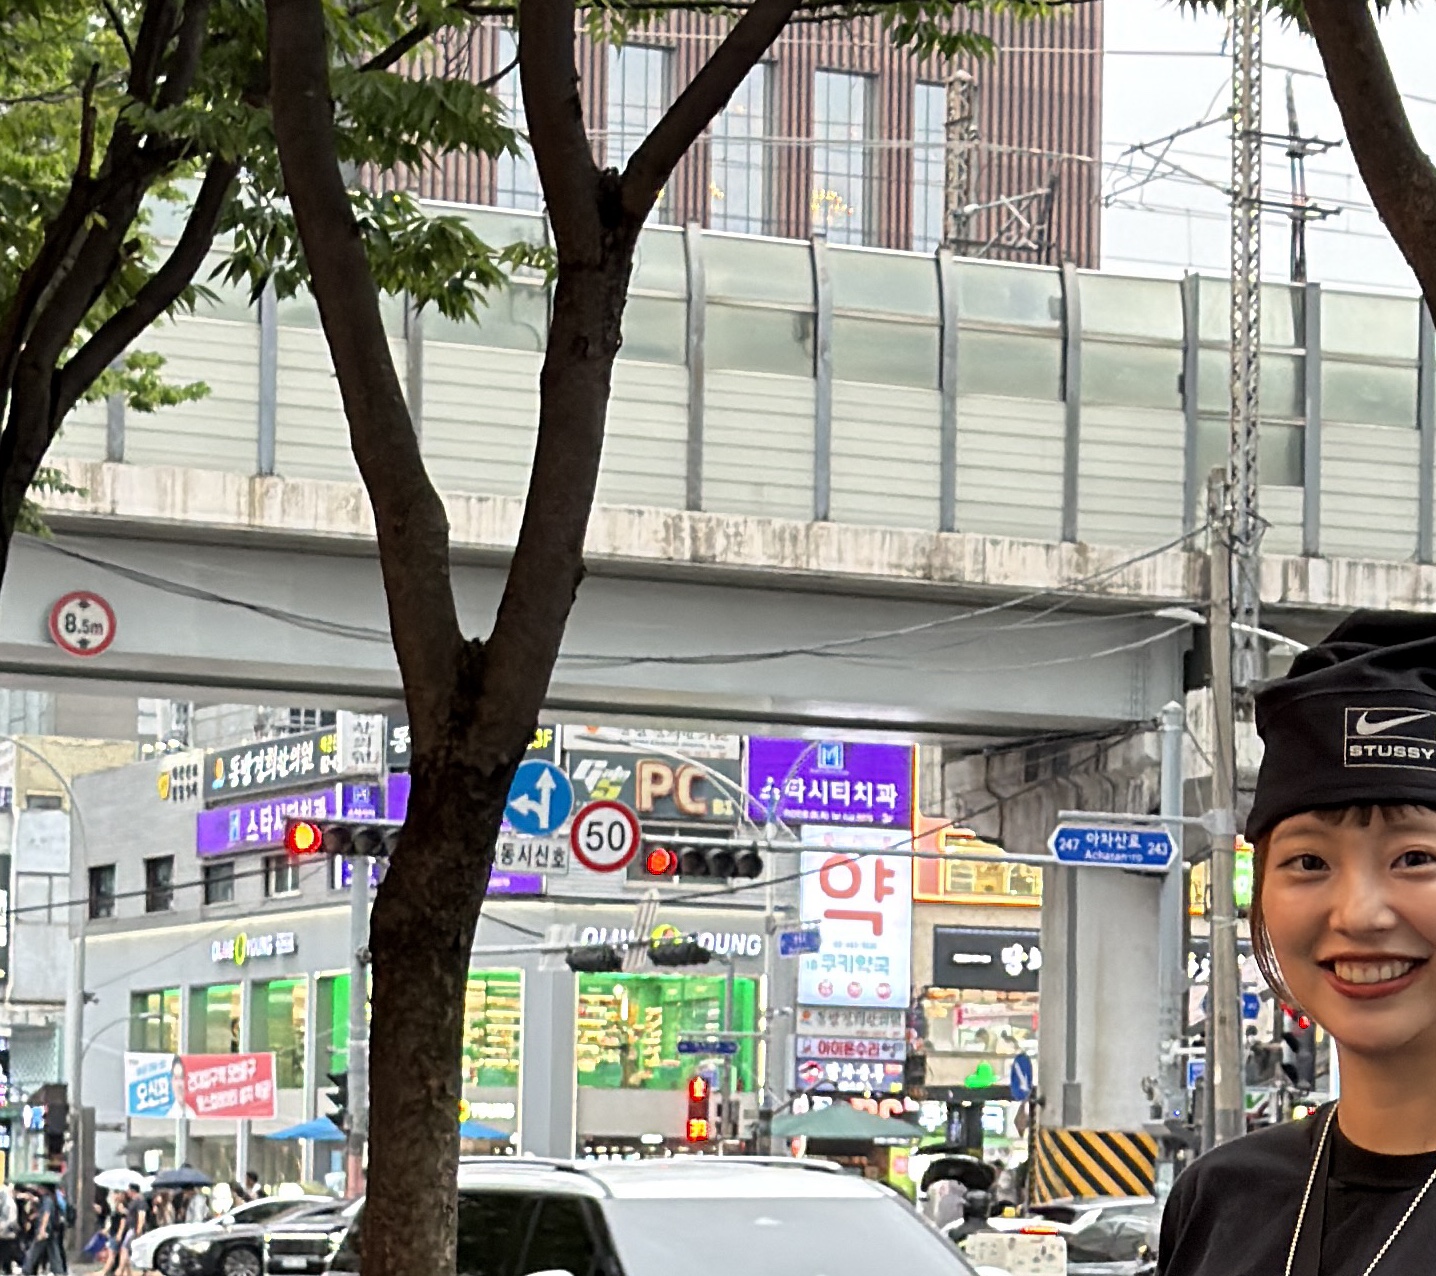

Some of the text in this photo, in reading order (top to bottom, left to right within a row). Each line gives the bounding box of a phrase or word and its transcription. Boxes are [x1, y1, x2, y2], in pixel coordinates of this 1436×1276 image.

[65, 612, 104, 636] 8.5m
[1349, 744, 1435, 760] STUSSY
[635, 758, 708, 815] PC
[586, 820, 625, 851] 50
[1058, 838, 1080, 851] 247
[501, 842, 565, 868] 동시신호
[820, 853, 895, 936] 약
